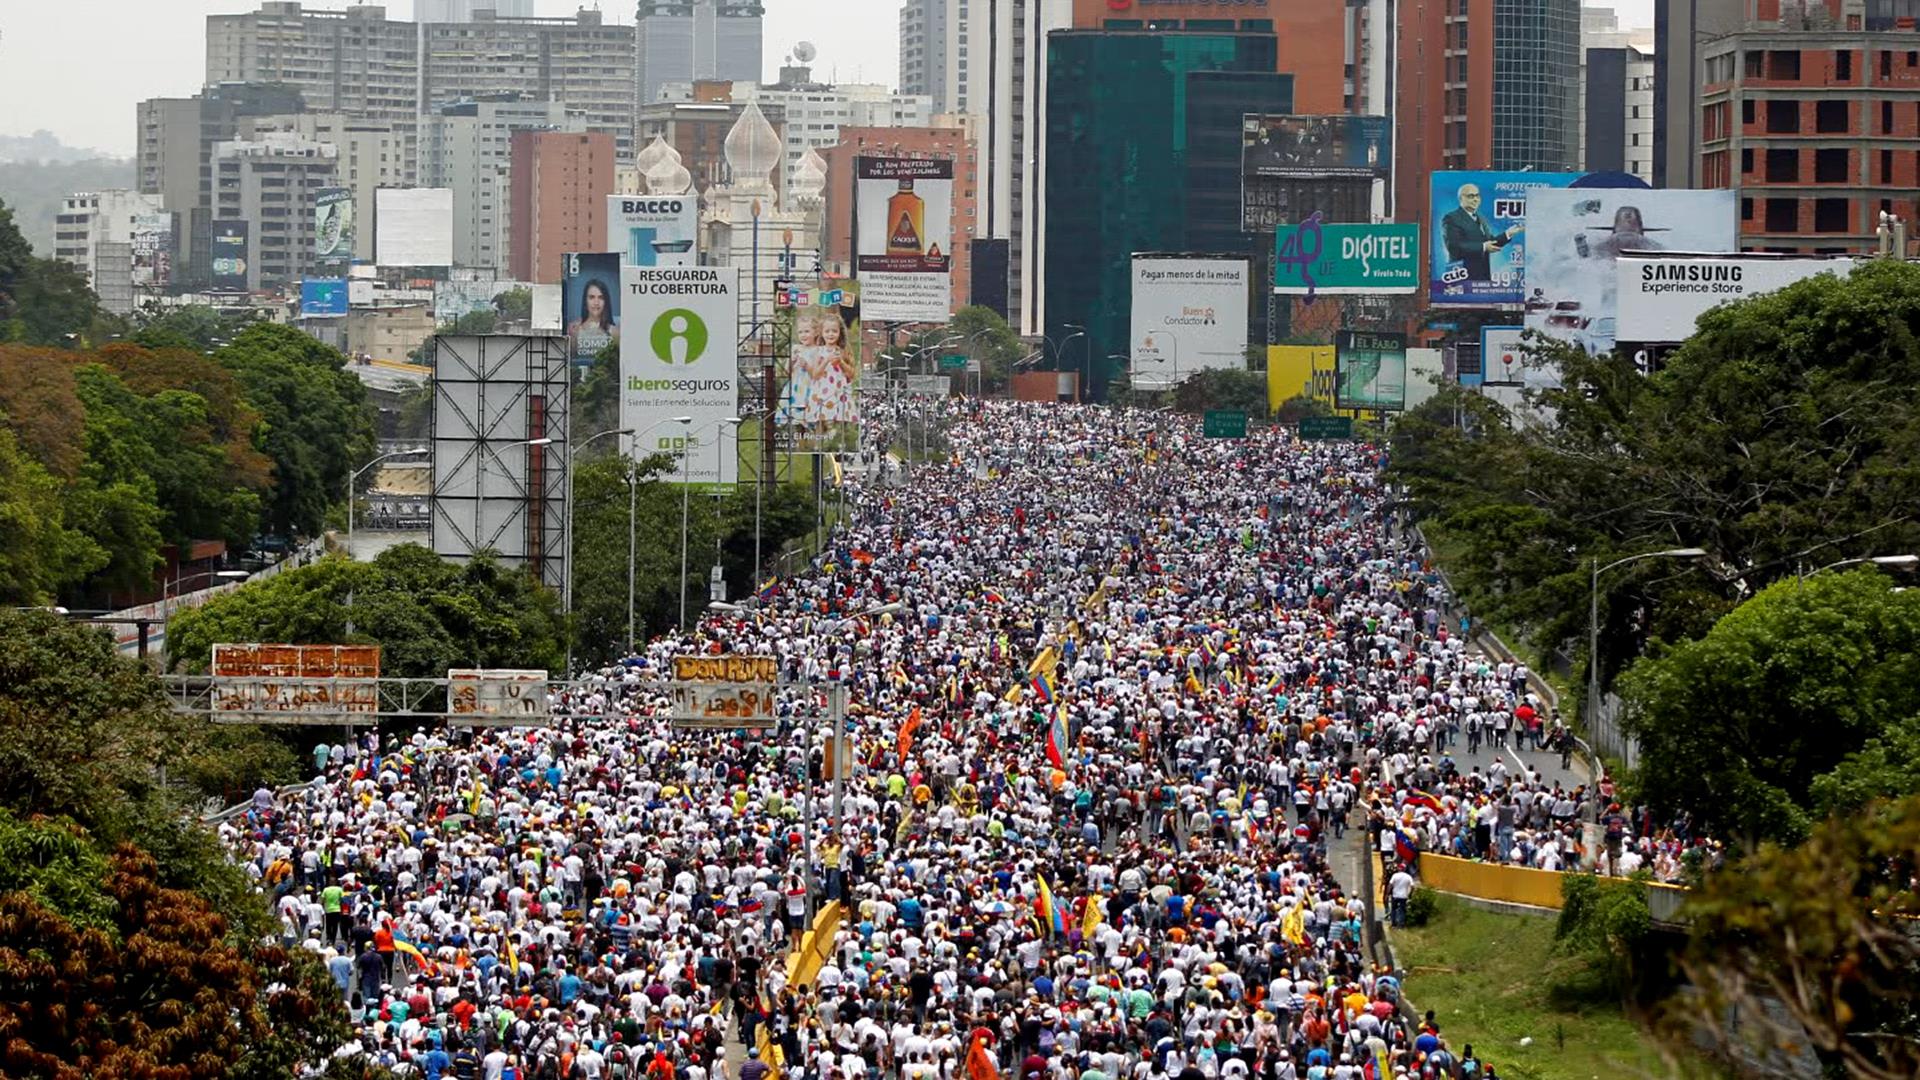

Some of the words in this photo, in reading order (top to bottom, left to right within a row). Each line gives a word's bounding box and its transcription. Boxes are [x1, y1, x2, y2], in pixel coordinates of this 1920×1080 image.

[621, 200, 683, 214] BACCO
[639, 270, 718, 282] RESGUARDA
[1141, 269, 1166, 281] Pagas
[1166, 271, 1194, 280] menos
[1195, 269, 1206, 280] de
[1206, 270, 1215, 279] la
[1215, 270, 1240, 280] mitad
[1641, 264, 1743, 282] SAMSUNG
[630, 283, 648, 295] TU
[650, 283, 729, 295] COBERTURA
[1641, 282, 1708, 295] Experience
[1711, 282, 1744, 294] Store
[1182, 306, 1204, 316] Buen
[1164, 315, 1203, 326] Conductor
[1356, 338, 1368, 349] EL
[1371, 339, 1399, 349] FARO
[627, 375, 731, 395] iberoseguros
